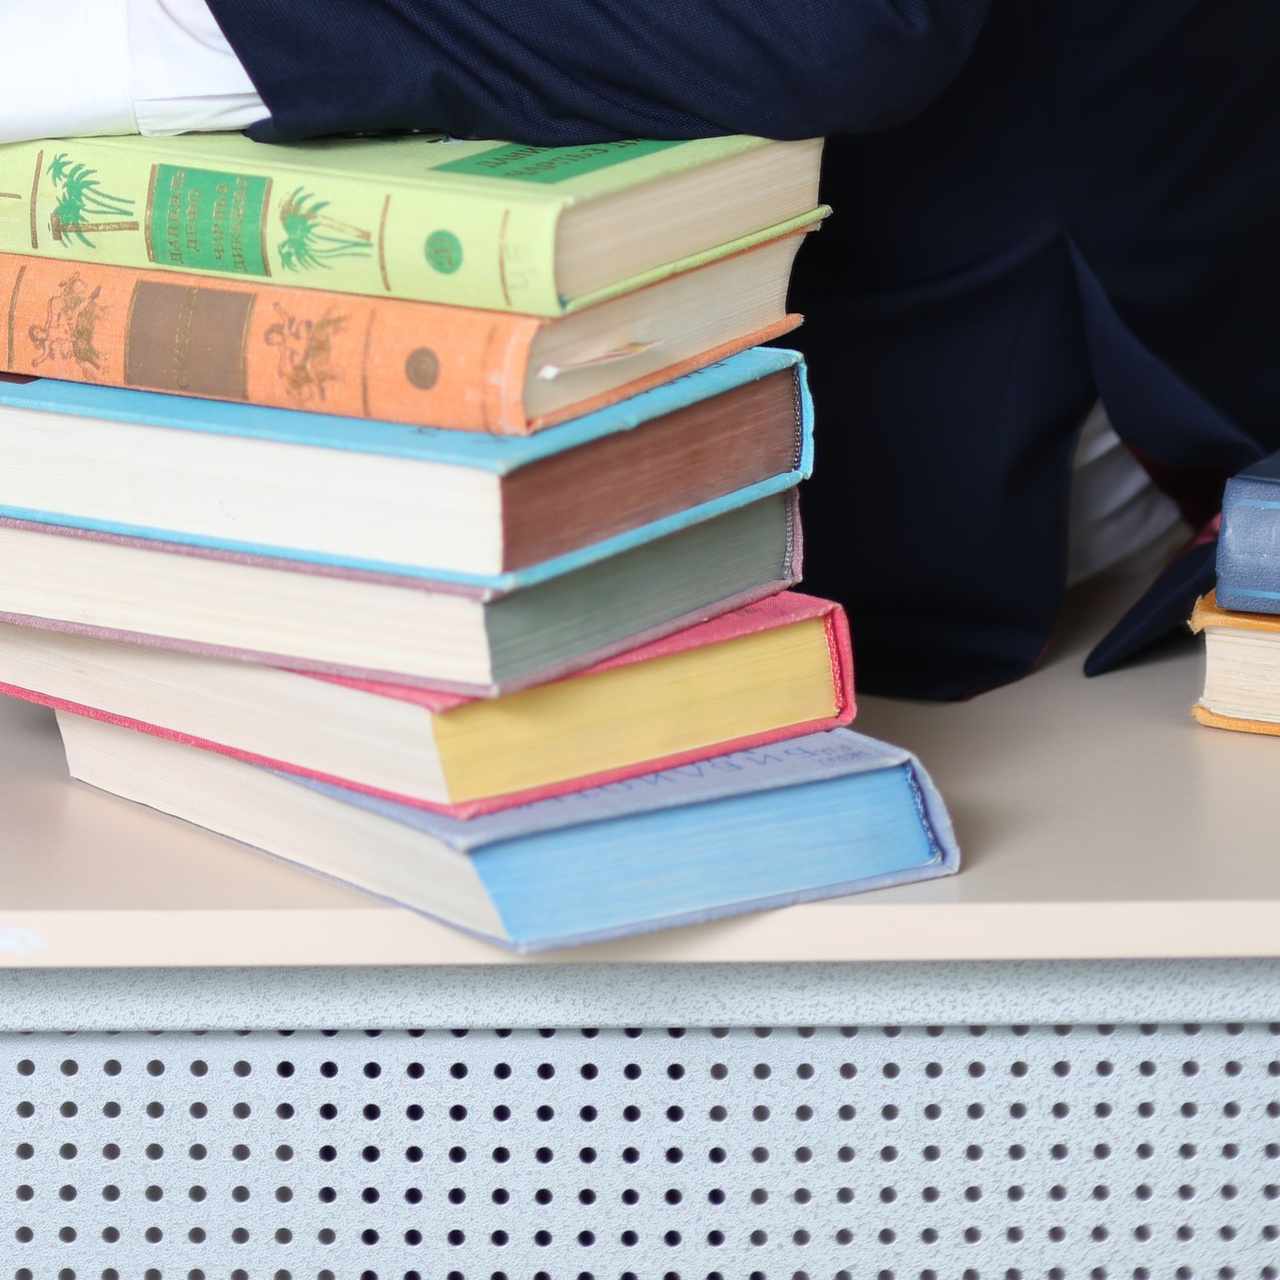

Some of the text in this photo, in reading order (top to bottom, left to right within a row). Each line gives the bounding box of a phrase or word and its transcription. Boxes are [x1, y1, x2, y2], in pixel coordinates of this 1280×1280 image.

[475, 143, 548, 169] ДАНИ
[166, 168, 185, 265] ДАНИЭЛЬ
[185, 187, 201, 253] ДЕФО
[211, 183, 229, 261] ЧАРЛЬЗ
[229, 176, 249, 273] ДИККЕНС
